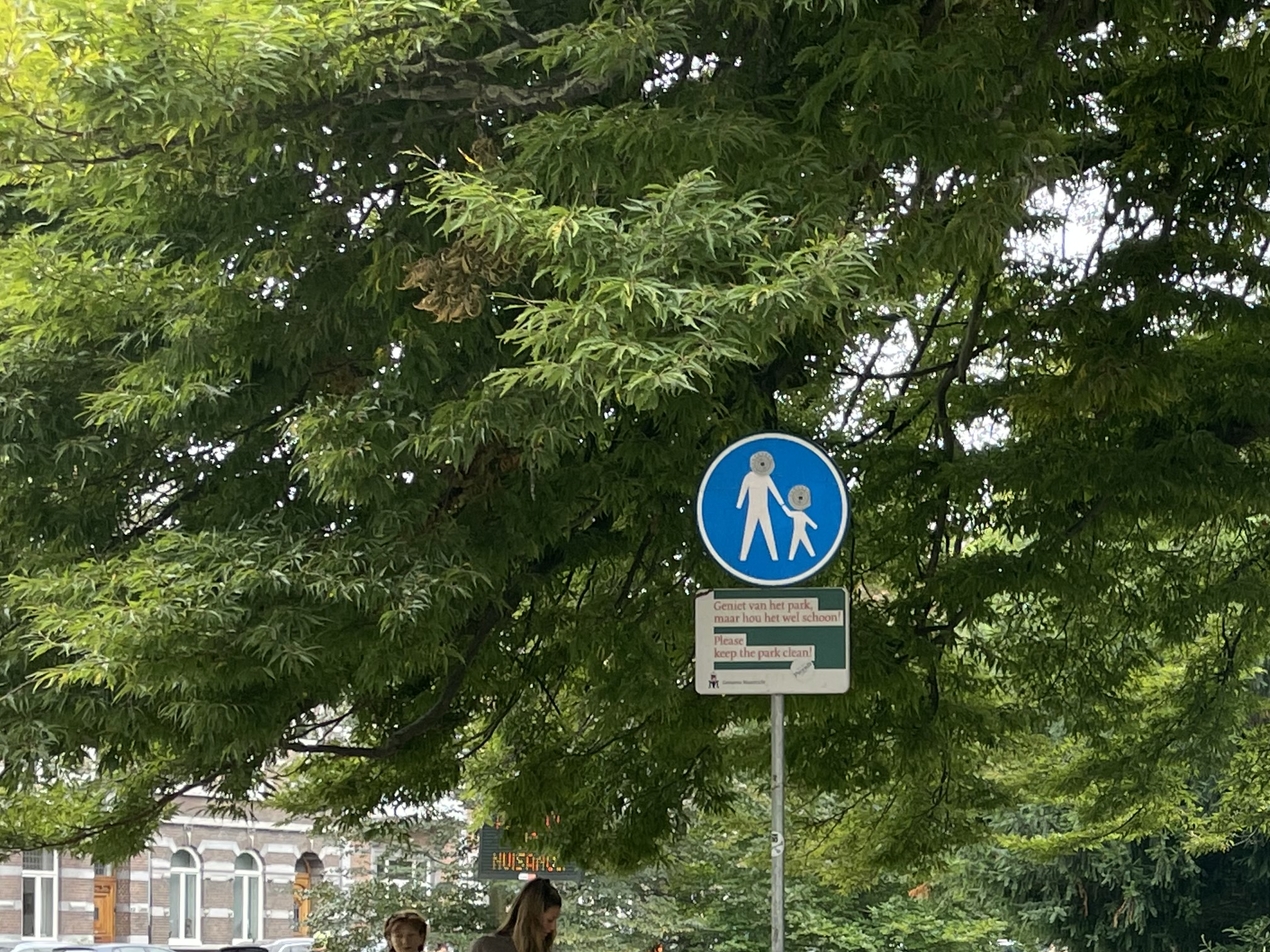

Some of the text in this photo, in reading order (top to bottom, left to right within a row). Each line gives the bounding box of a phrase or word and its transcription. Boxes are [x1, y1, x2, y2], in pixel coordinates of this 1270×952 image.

[714, 599, 814, 614] Geniet van het park,
[714, 611, 841, 623] maar hou het wel schoon!
[714, 635, 744, 646] Please
[714, 646, 812, 660] keep the park clean!
